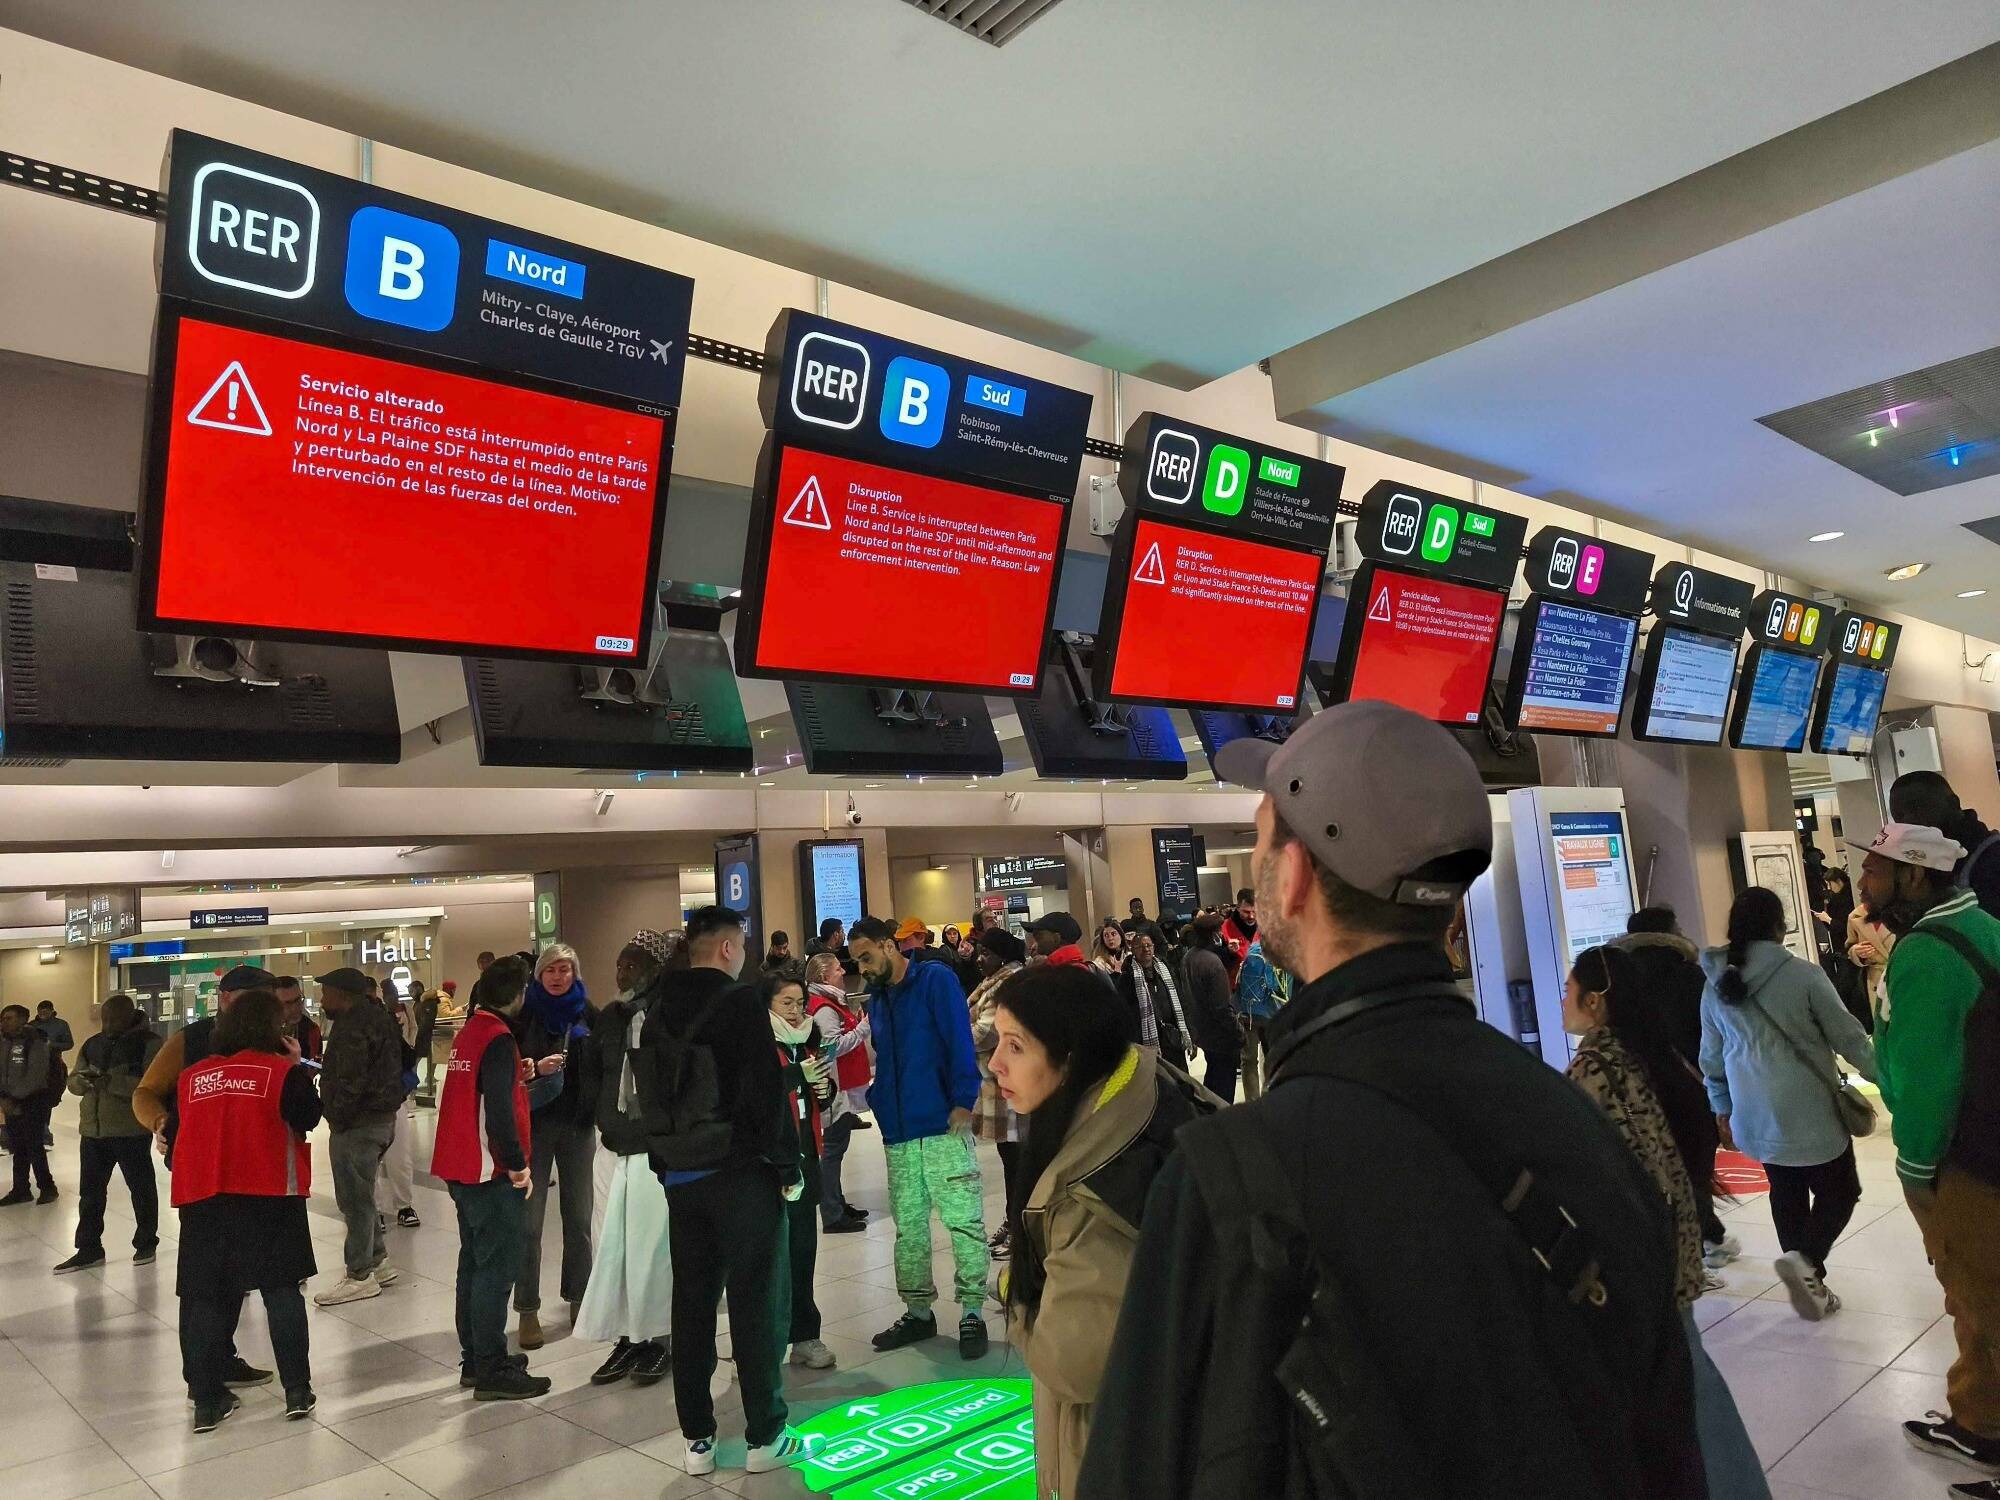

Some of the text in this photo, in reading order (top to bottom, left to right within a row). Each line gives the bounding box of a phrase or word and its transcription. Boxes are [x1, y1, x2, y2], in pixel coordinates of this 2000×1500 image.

[209, 200, 567, 301] RER B Nord
[482, 289, 641, 343] Mitry Claye, Aéroport
[480, 309, 645, 360] Charles de Gaulle 2 TGV
[300, 374, 444, 414] Servicio alterado
[804, 360, 1009, 426] RER B Sud
[298, 395, 648, 473] Línea B. El tráfico está interrumpido entre París
[960, 414, 1001, 433] Robinson
[296, 416, 647, 491] Nord y La Plaine SDF hasta el medio de la tarde
[958, 429, 1068, 464] Saint-Rémy-lès-Chevreuse
[294, 441, 621, 505] y perturbado en el resto de la línea. Motivo:
[1156, 451, 1292, 498] RER D Nord
[292, 458, 577, 516] Intervención de las fuerzas del orden.
[849, 482, 902, 503] Disruption
[1256, 487, 1272, 498] Stade
[1282, 494, 1300, 505] France
[846, 498, 1037, 544] Line B. Service is interrupted between Paris
[1290, 520, 1303, 529] Creil
[1389, 511, 1487, 548] RER D Sud
[844, 514, 1053, 561] Nord and La Plaine SDF until mid-afternoon and
[840, 548, 960, 575] enforcement intervention.
[842, 531, 1041, 573] disrupted on the rest of the line. Reason: Law
[1178, 547, 1212, 560] Disruption
[1176, 559, 1315, 591] RER Service interrupted between Paris Gare
[1553, 553, 1597, 584] RER E
[1172, 585, 1184, 593] and
[1185, 587, 1222, 601] significantly
[1223, 594, 1244, 603] slowed
[1184, 574, 1198, 584] Lyon
[1212, 579, 1229, 588] Stade
[1231, 582, 1251, 592] France
[1252, 585, 1276, 596] St-Denis
[1278, 590, 1290, 598] until
[1557, 608, 1578, 620] Nanterre
[1694, 597, 1727, 614] Informations
[1789, 612, 1816, 637] H K
[600, 638, 629, 651] 09:29
[1552, 634, 1570, 645] Chelles
[1571, 638, 1591, 649] Gournay
[1862, 629, 1885, 651] H K
[1545, 673, 1566, 684] Nanterre
[1547, 660, 1569, 671] Nanterre
[1543, 686, 1581, 698] Tournan-en-Brie
[1563, 840, 1588, 849] TRAVAUX
[731, 874, 743, 901] B
[542, 901, 552, 924] D
[361, 937, 418, 964] Hall
[194, 1070, 224, 1087] SNCF
[823, 1392, 1006, 1466] RER D Nord
[896, 1442, 1026, 1496] D Sud
